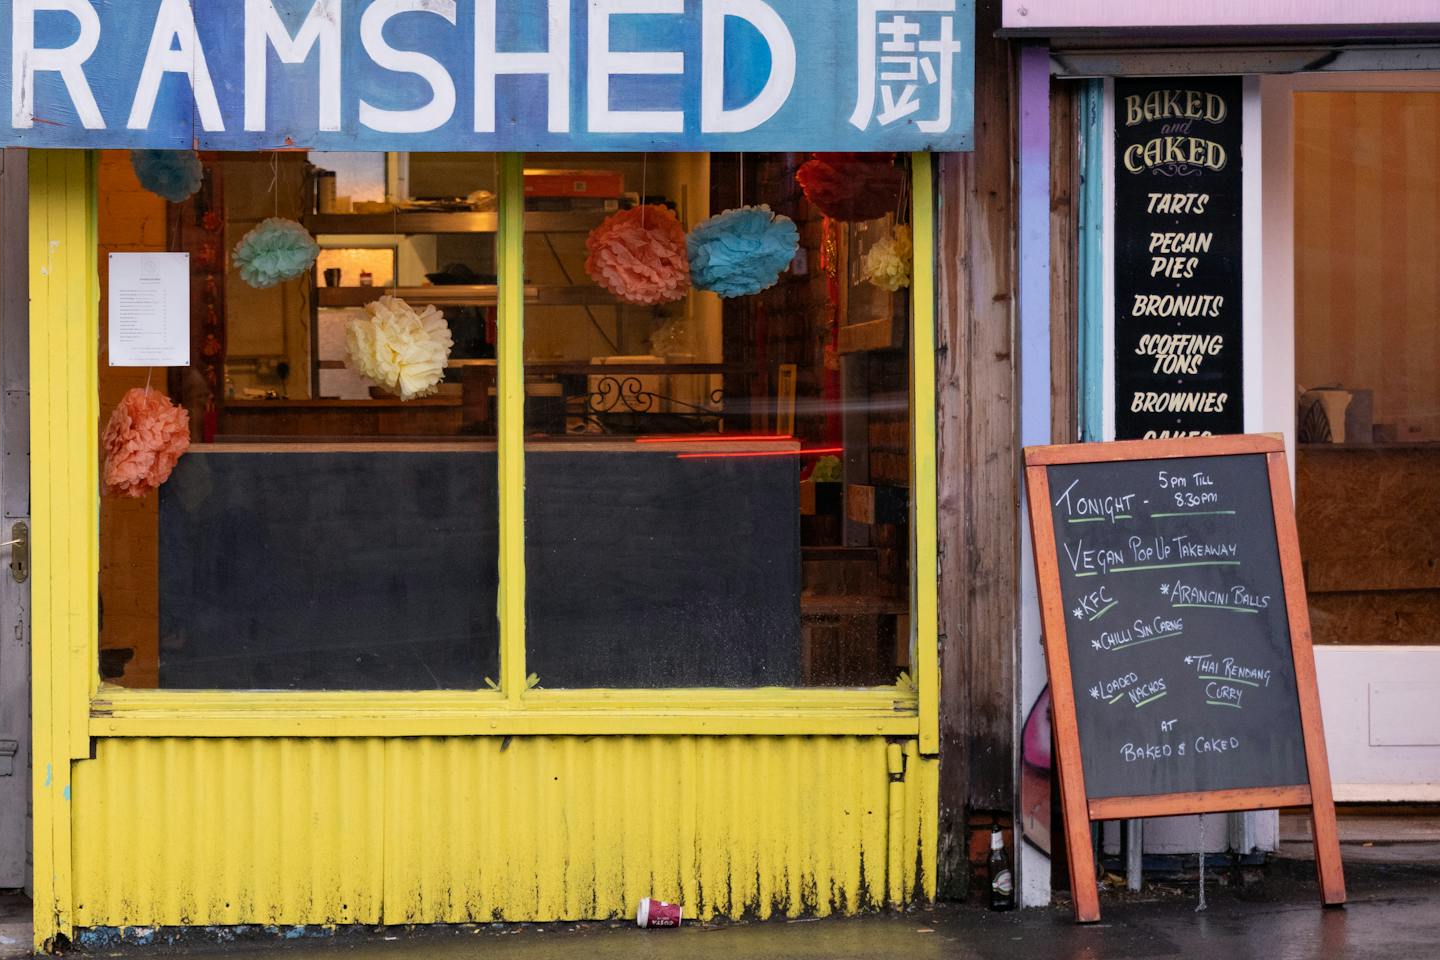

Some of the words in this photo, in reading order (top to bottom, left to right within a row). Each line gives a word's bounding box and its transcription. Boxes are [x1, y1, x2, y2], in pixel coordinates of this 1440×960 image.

[1124, 89, 1228, 127] BAKED
[1161, 119, 1192, 134] and
[1124, 136, 1228, 174] CAKED
[1147, 193, 1210, 214] TARTS
[1149, 232, 1213, 253] PECAN
[1150, 257, 1199, 278] PIES
[1131, 294, 1224, 317] BRONUTS
[1135, 334, 1224, 355] SCOFFING
[1153, 354, 1203, 374] TONS
[1130, 392, 1228, 413] BROWNIES
[1078, 585, 1113, 615] KFC
[1161, 719, 1178, 732] AT
[1120, 742, 1172, 762] BAKED
[1195, 737, 1239, 754] CAKED
